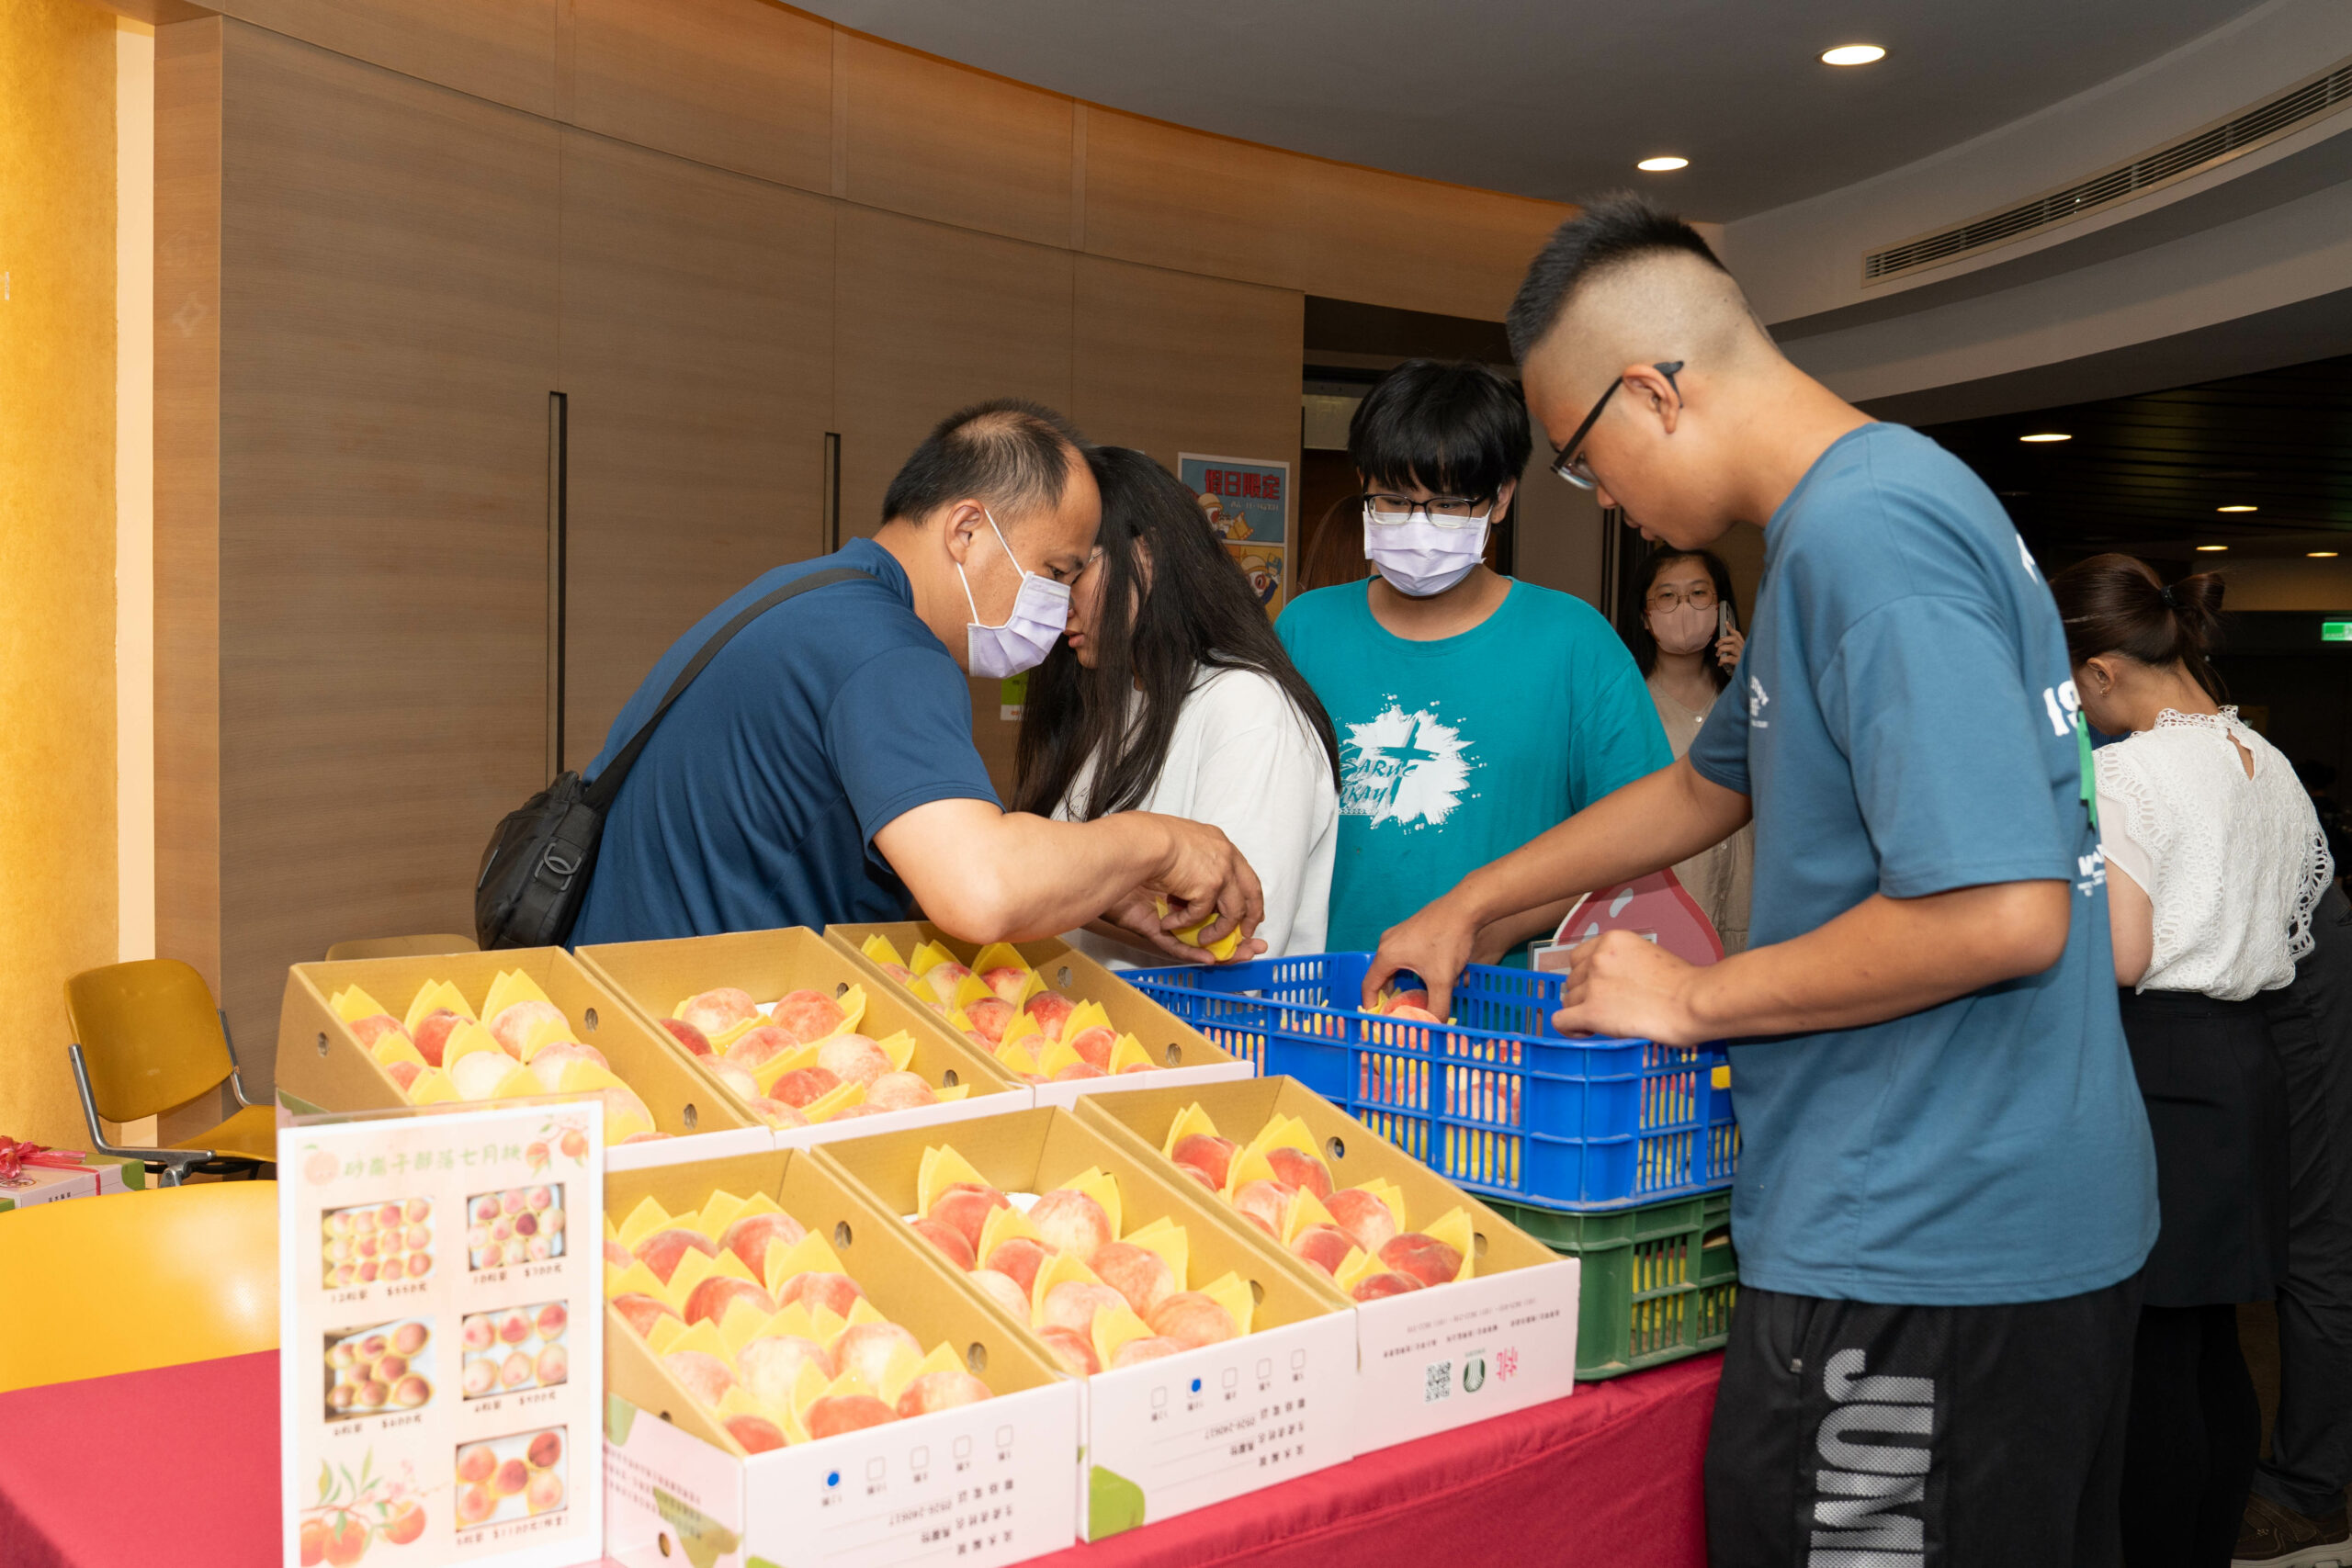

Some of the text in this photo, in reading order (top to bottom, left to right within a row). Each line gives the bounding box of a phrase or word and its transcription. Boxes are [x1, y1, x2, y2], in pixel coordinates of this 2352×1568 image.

[1205, 469, 1280, 500] 假日限定
[1807, 1348, 1935, 1568] JUM
